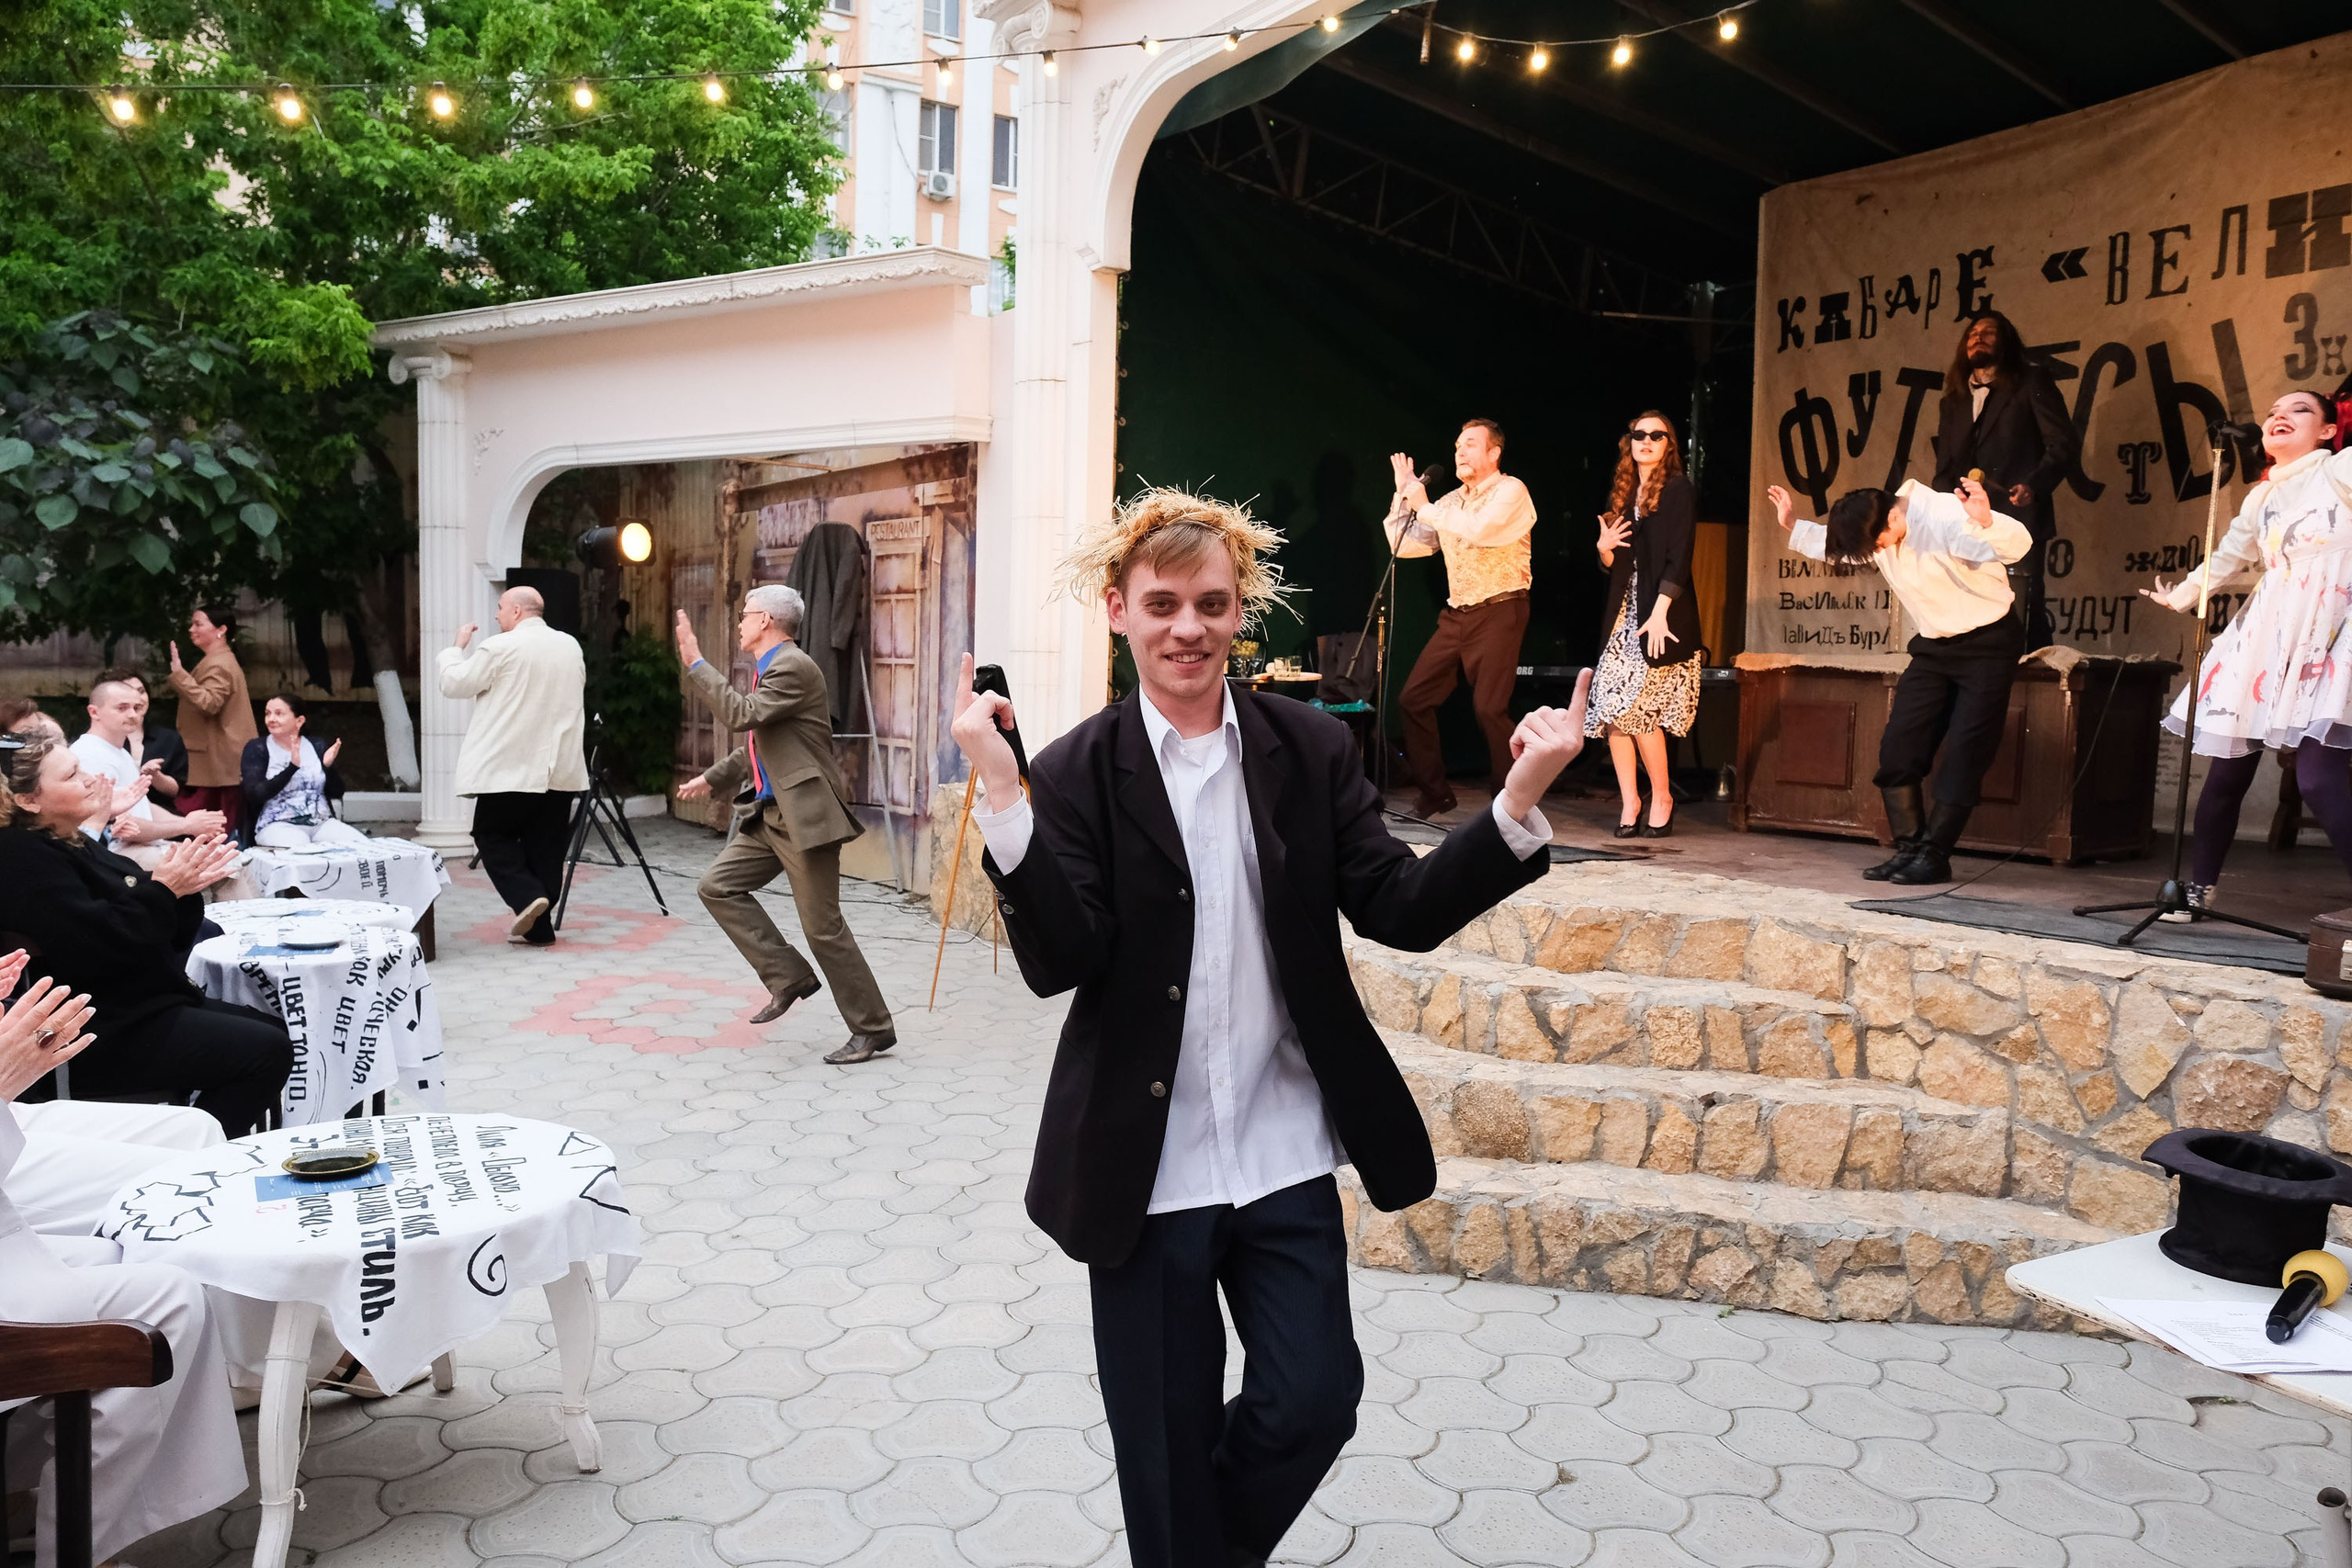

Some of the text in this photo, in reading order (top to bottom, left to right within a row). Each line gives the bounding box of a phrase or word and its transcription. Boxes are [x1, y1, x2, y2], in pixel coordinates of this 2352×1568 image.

[1516, 666, 1533, 675] ORG
[280, 976, 308, 1028] ЦВЕТ
[332, 996, 356, 1055] ЦВЕТ
